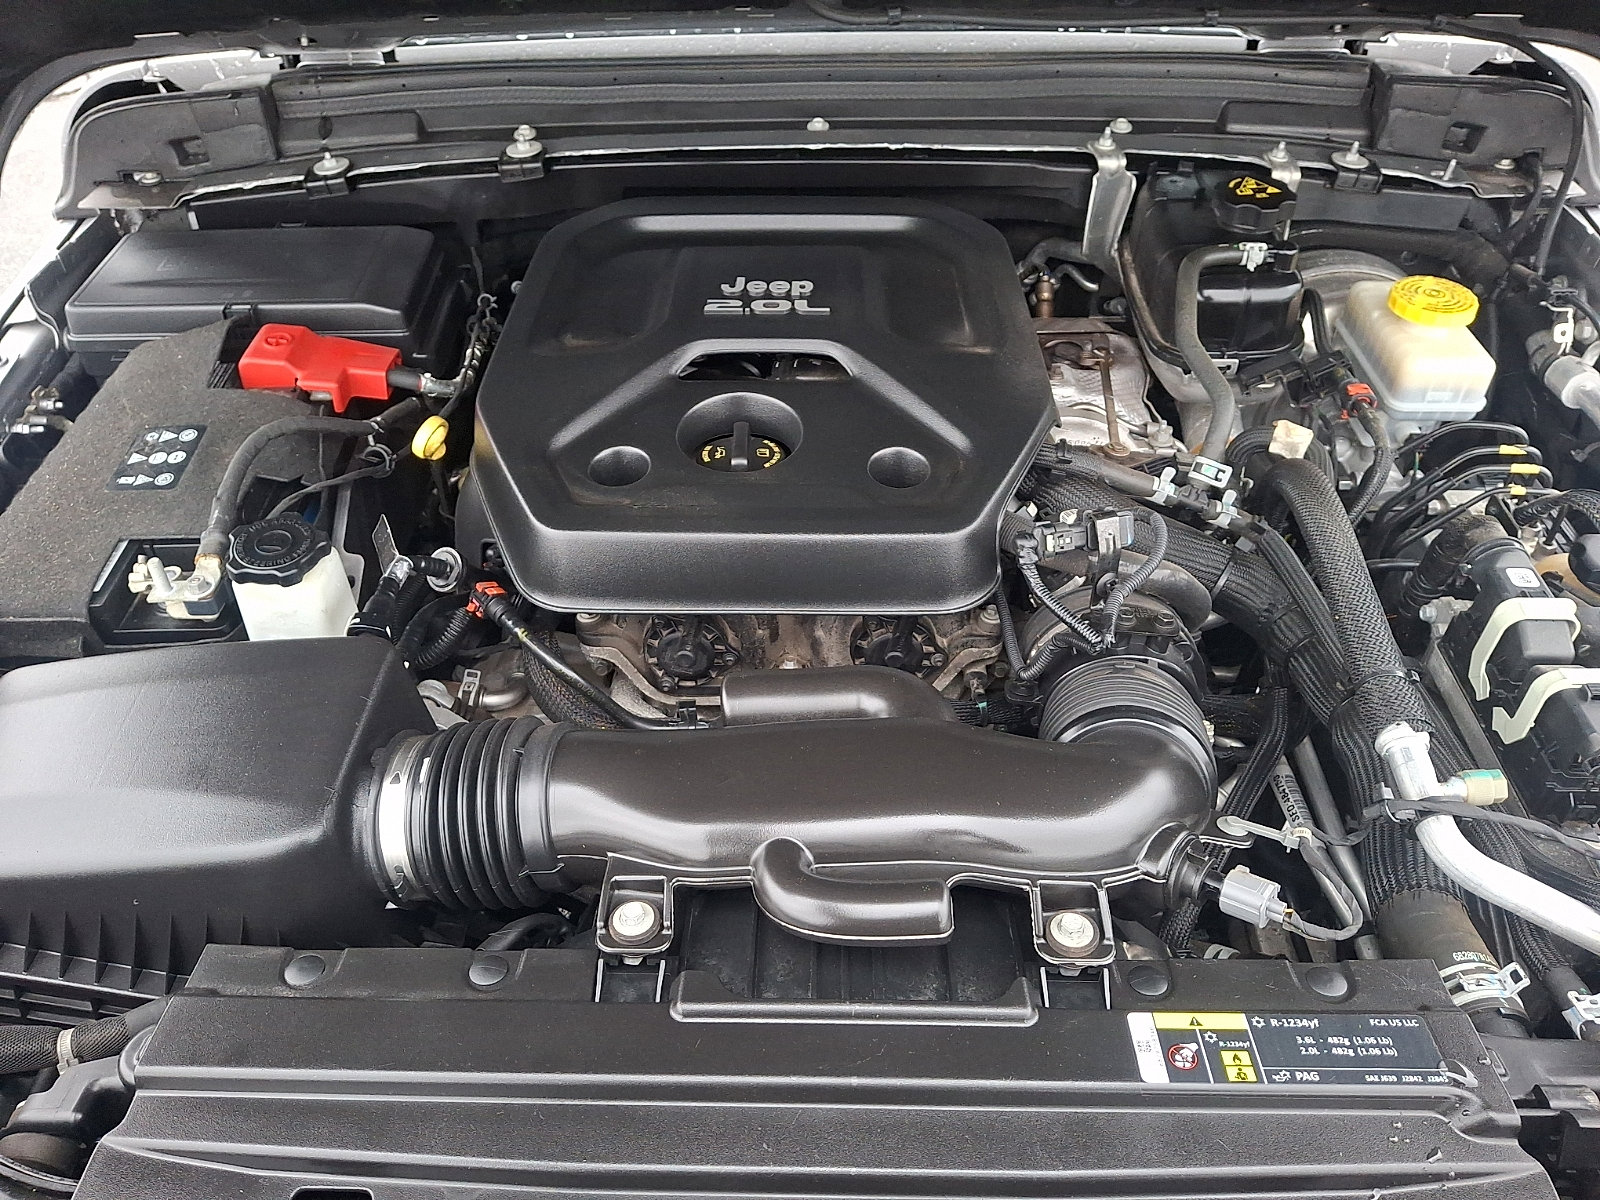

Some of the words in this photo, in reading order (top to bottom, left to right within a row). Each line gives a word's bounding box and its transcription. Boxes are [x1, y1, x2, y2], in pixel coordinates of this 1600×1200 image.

[720, 276, 814, 299] Jeep
[703, 299, 830, 315] 2.0L
[1269, 1018, 1320, 1029] R-1234yf
[1369, 1019, 1389, 1027] FCA
[1389, 1019, 1402, 1027] US
[1402, 1019, 1419, 1027] LLC
[1296, 1036, 1317, 1044] 3.6L
[1300, 1047, 1321, 1055] 2.0L
[1295, 1071, 1320, 1081] PAG
